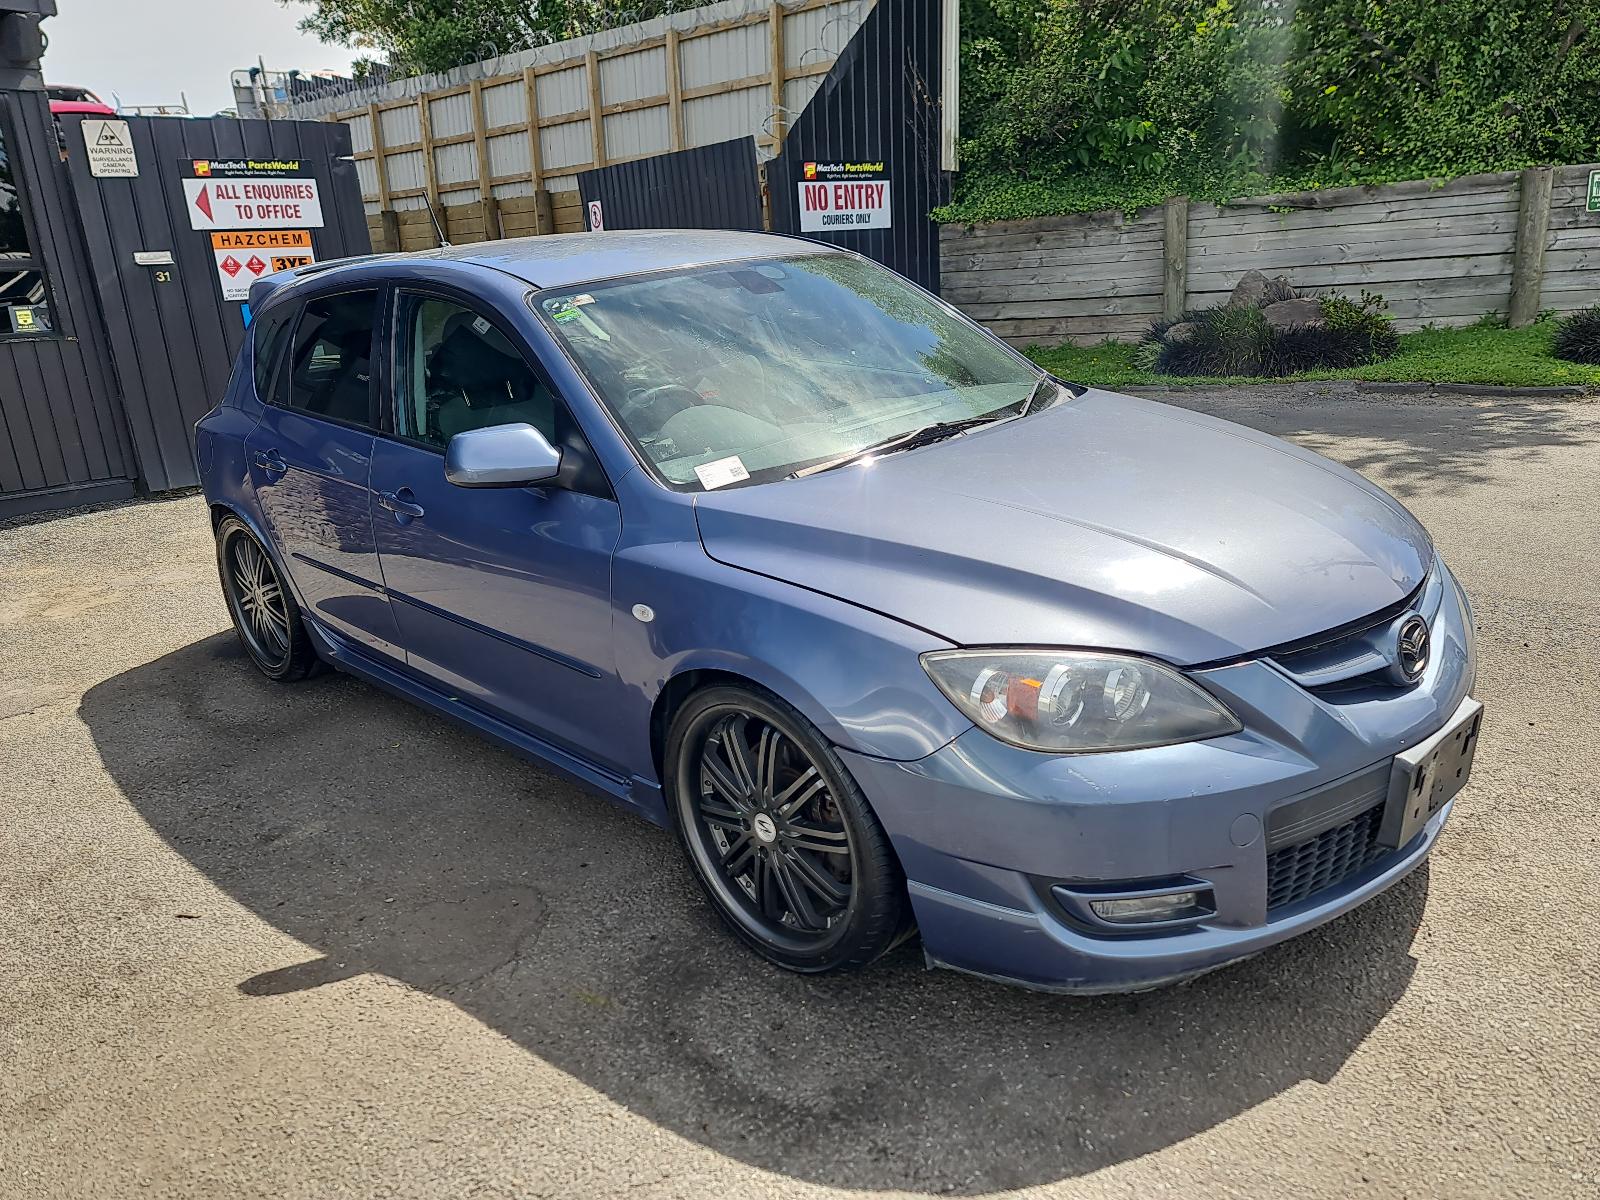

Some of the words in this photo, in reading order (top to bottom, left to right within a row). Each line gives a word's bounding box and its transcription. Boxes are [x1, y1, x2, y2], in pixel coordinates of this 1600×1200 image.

[89, 147, 134, 155] WARNING
[210, 160, 246, 170] MazTech
[248, 160, 299, 170] PartsWorld
[816, 162, 844, 172] MazTech
[845, 162, 884, 172] PartsWorld
[216, 185, 240, 200] ALL
[243, 184, 313, 201] ENQUIRIES
[804, 184, 829, 212] NO
[834, 183, 884, 211] ENTRY
[235, 204, 253, 220] TO
[257, 204, 302, 219] OFFICE
[822, 214, 854, 226] COURIERS
[856, 213, 871, 224] ONLY
[221, 233, 303, 246] HAZCHEM
[155, 271, 171, 282] 31
